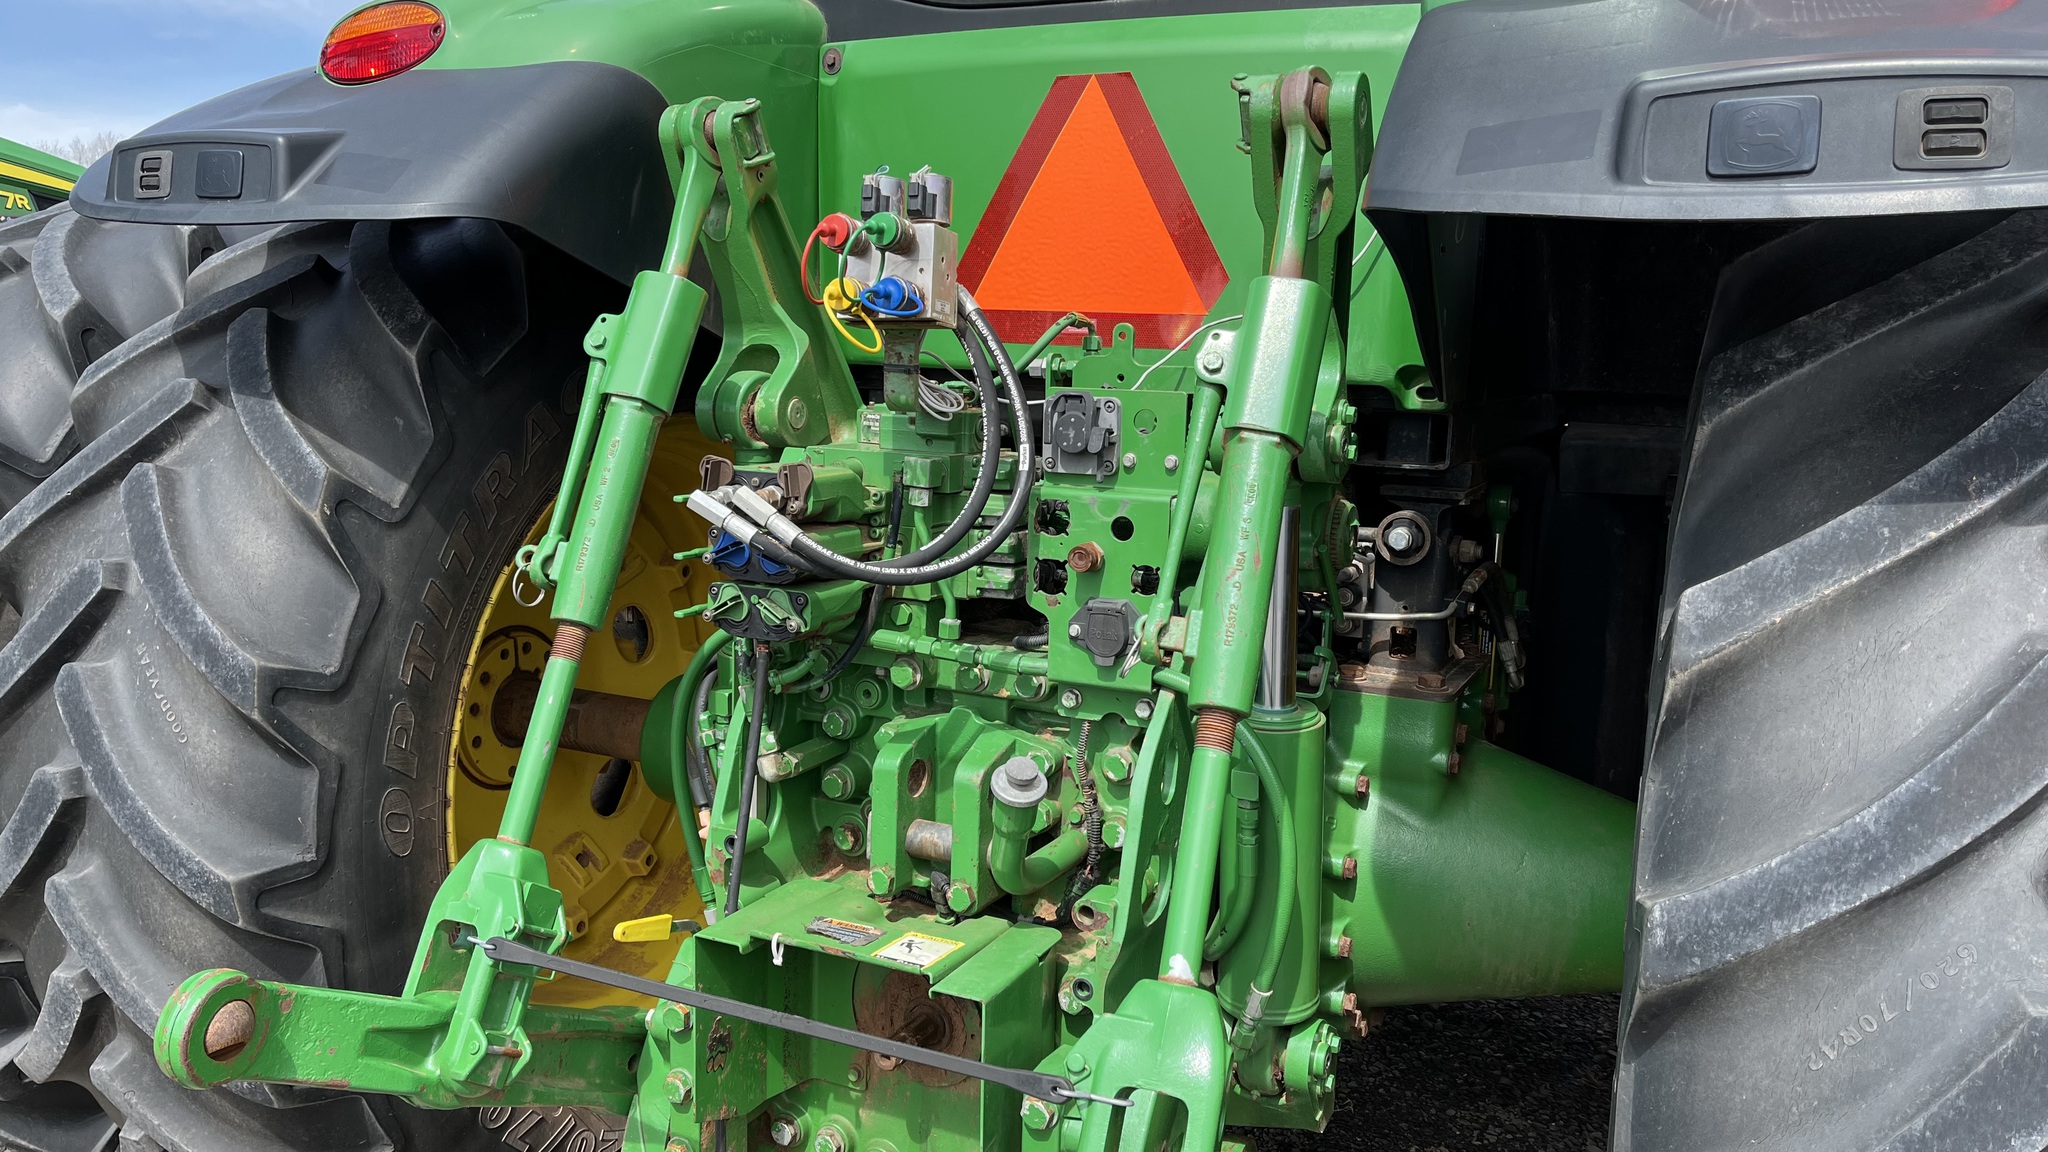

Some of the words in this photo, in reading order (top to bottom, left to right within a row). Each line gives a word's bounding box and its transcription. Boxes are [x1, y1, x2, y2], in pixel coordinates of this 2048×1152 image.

[0, 190, 32, 211] 7R
[987, 335, 998, 351] MPa
[1000, 363, 1009, 377] WP
[1006, 375, 1021, 411] Worldwide
[575, 536, 591, 571] R179372
[592, 493, 604, 512] USA
[856, 561, 866, 569] 10
[866, 564, 881, 573] mm
[881, 566, 899, 575] (3/8)
[938, 556, 961, 568] MADE
[960, 552, 969, 560] IN
[967, 535, 993, 556] MEXICO
[1224, 603, 1239, 647] R179372
[1236, 551, 1248, 572] USA
[1090, 627, 1118, 641] Pollak
[922, 934, 960, 946] CAUTION
[1803, 942, 1979, 1071] 620/70R42
